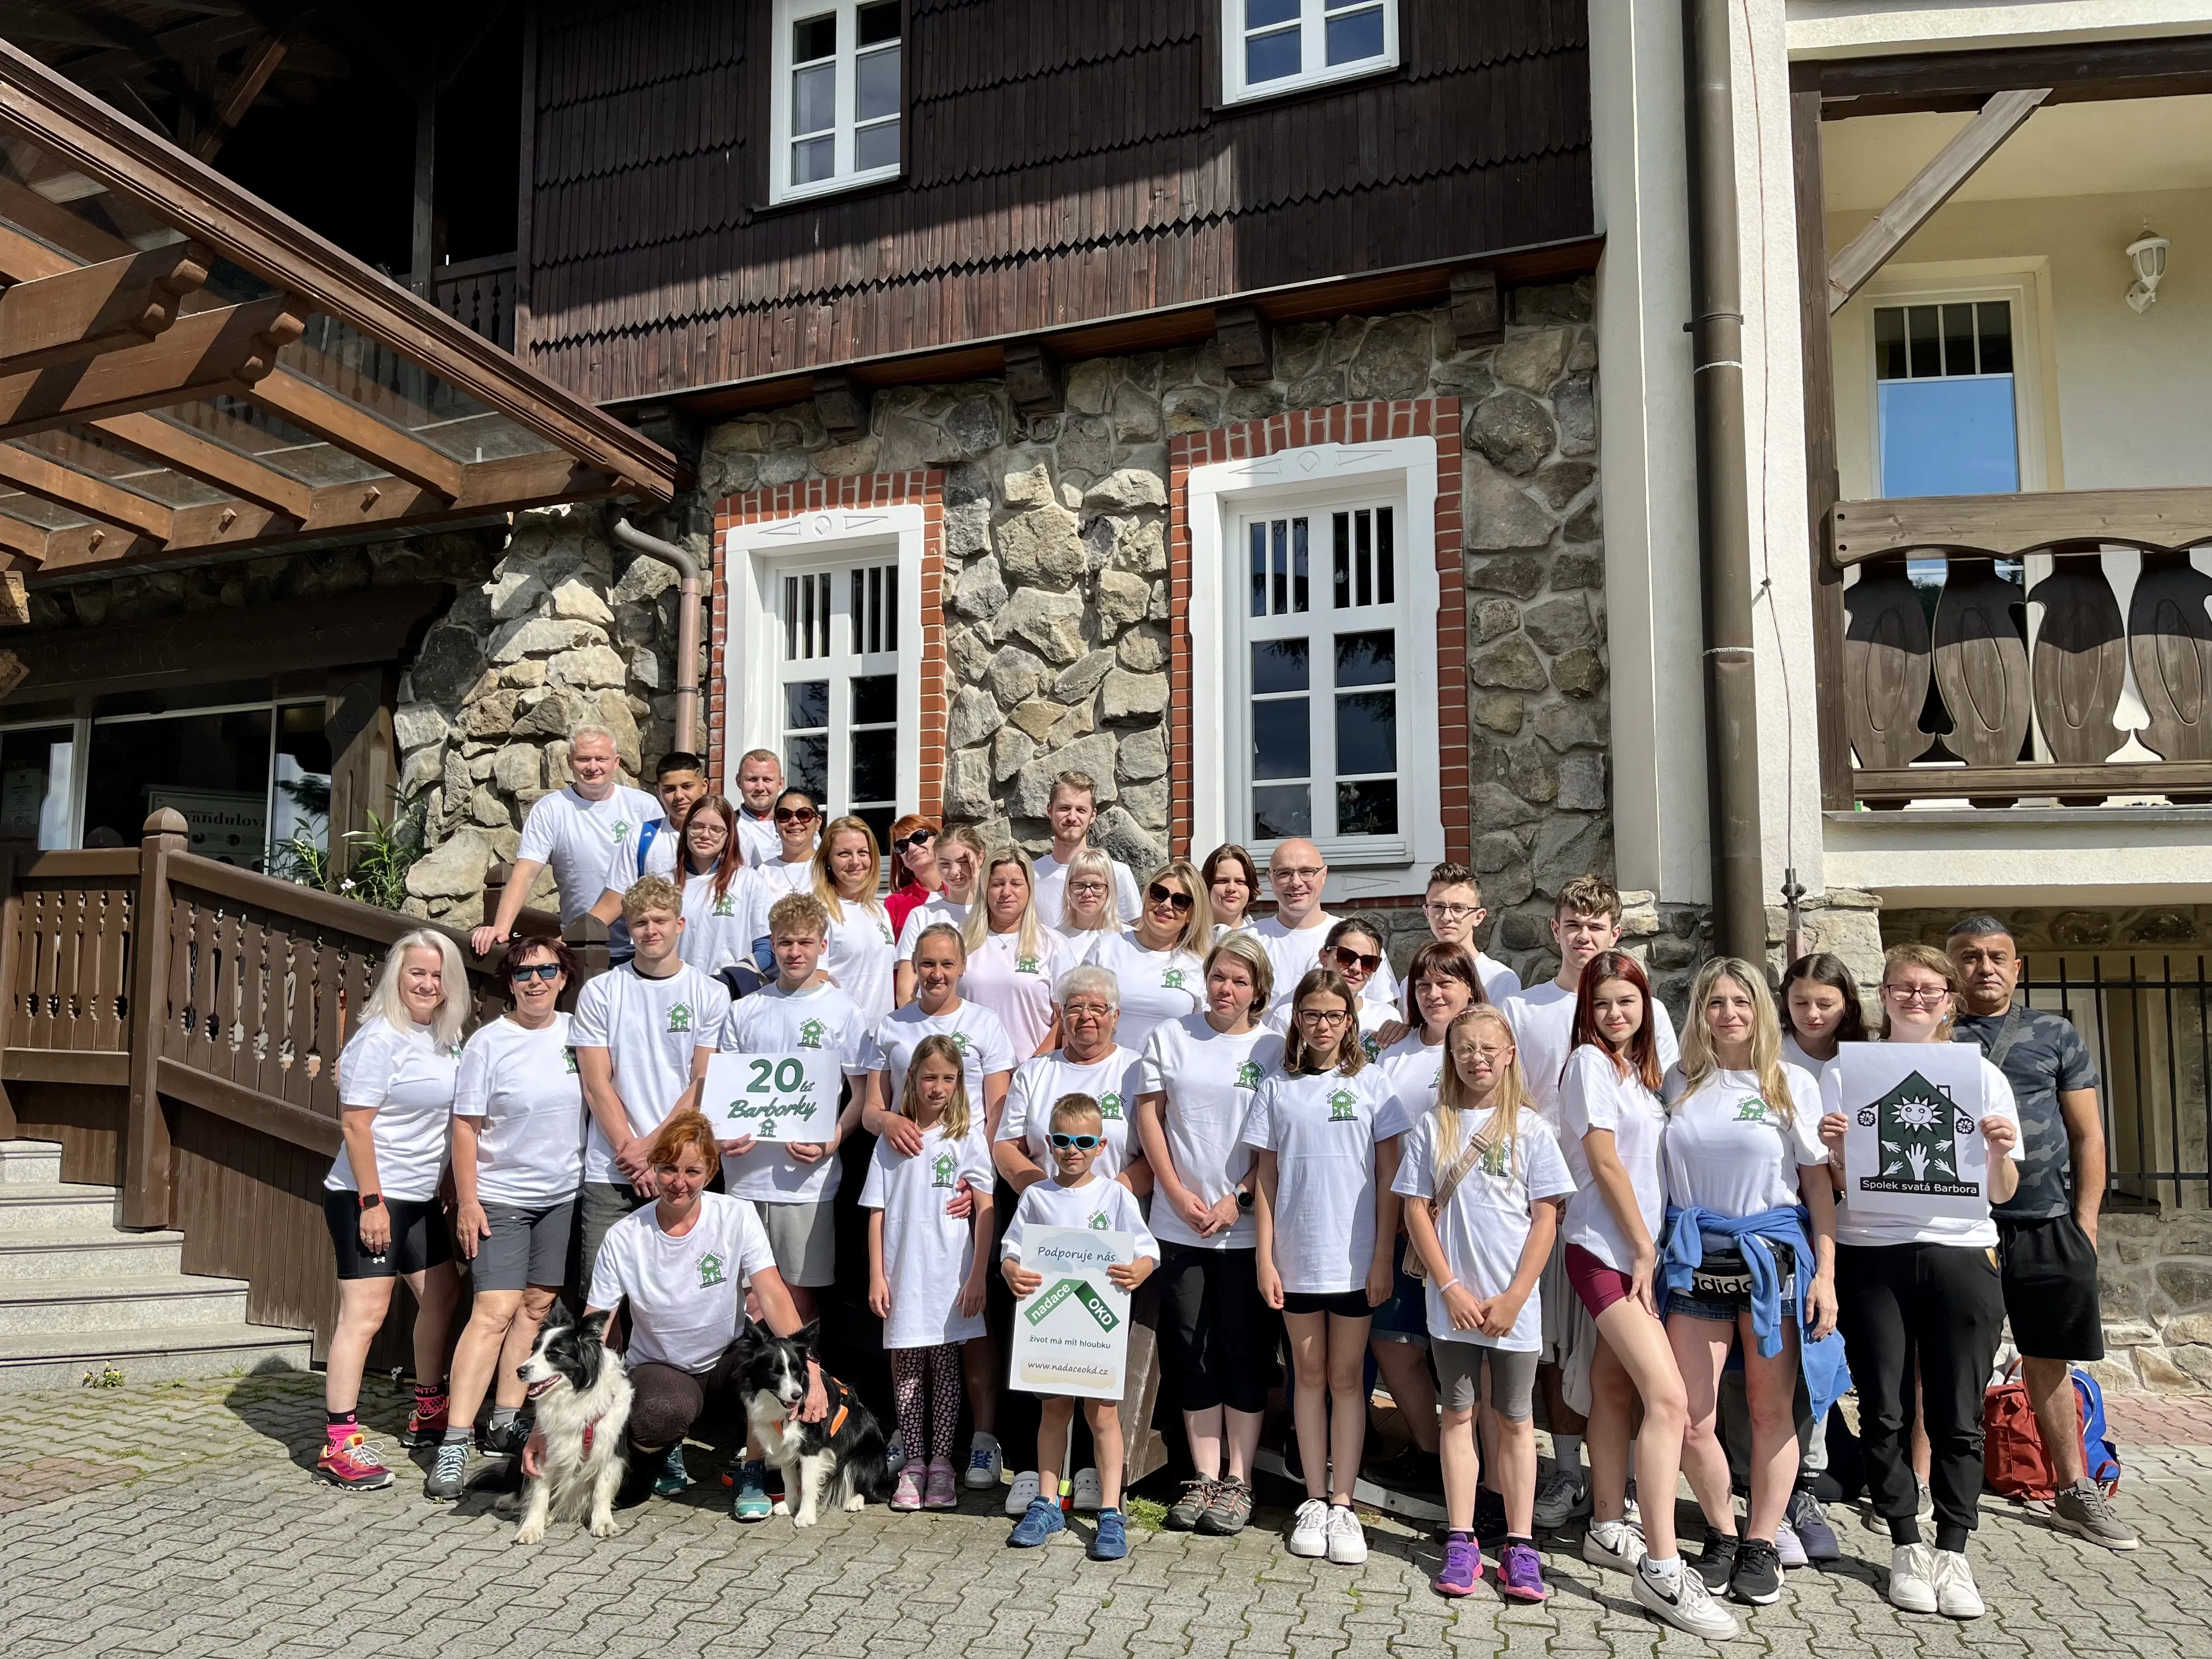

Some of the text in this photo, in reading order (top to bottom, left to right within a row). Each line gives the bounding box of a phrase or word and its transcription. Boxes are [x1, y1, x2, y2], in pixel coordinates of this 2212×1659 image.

[747, 1058, 815, 1093] 20 let
[727, 1094, 817, 1121] Barborky
[1863, 1180, 1977, 1194] Spolek svatá Barbora
[1038, 1246, 1115, 1262] Podporuje nás
[1031, 1283, 1070, 1321] nadace
[1088, 1297, 1113, 1325] OKD
[1029, 1334, 1048, 1344] život
[1065, 1338, 1077, 1346] mít
[1080, 1339, 1110, 1349] hloubku
[1028, 1361, 1108, 1376] www.nadaceokd.cz
